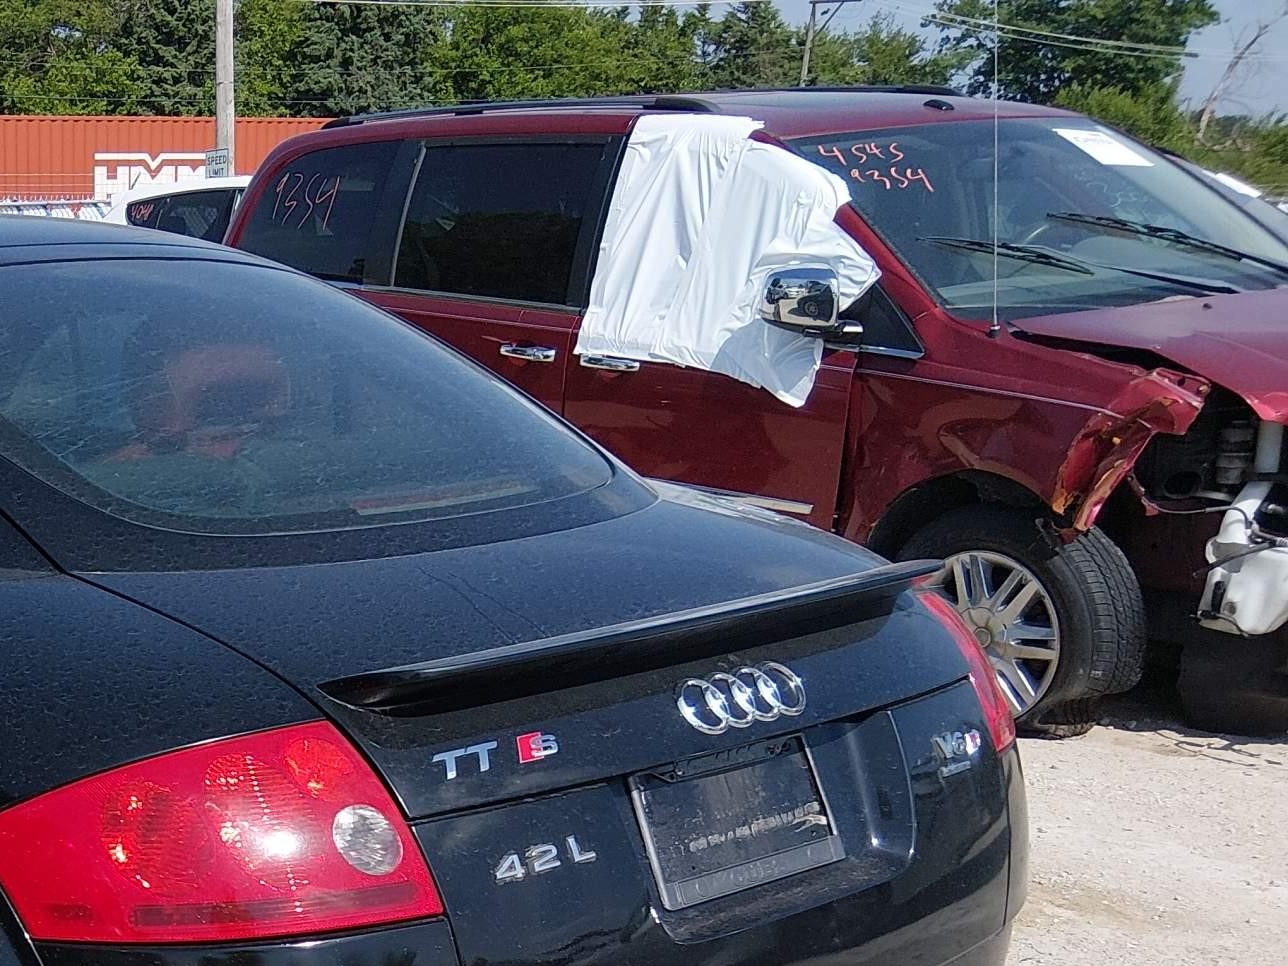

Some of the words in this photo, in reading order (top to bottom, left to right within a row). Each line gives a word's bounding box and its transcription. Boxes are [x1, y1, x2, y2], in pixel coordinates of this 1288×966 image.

[207, 154, 227, 166] SPEED
[818, 142, 904, 165] 4545
[850, 166, 934, 193] 9354
[431, 740, 498, 780] TT
